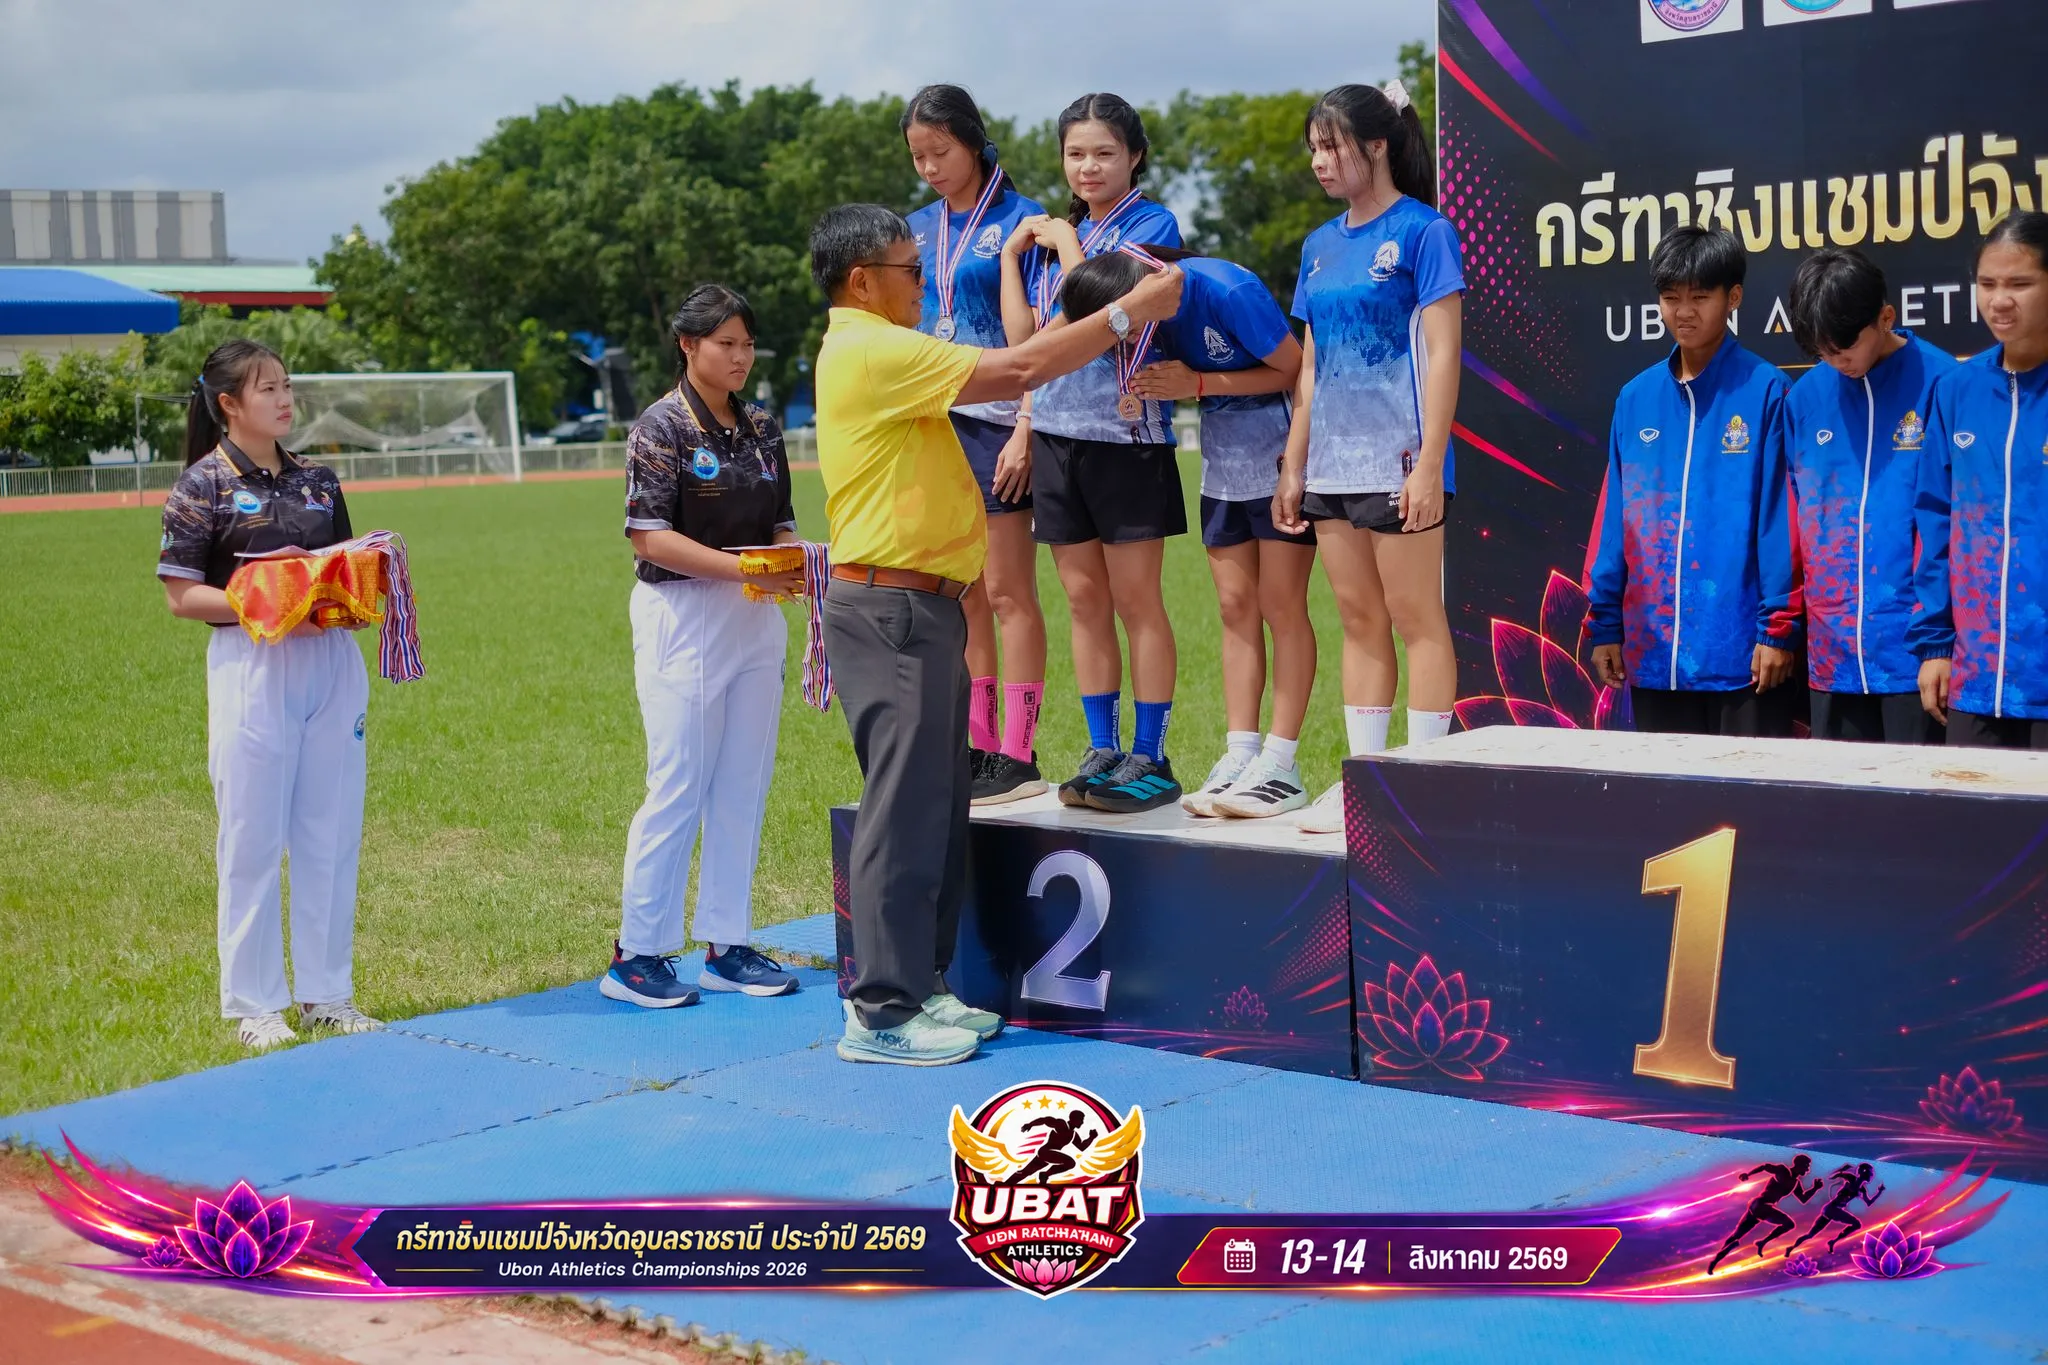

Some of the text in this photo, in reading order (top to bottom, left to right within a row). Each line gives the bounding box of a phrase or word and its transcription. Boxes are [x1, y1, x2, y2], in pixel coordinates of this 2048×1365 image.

[1021, 850, 1111, 1012] 2
[1633, 829, 1736, 1089] 1
[875, 1031, 912, 1050] HOKA
